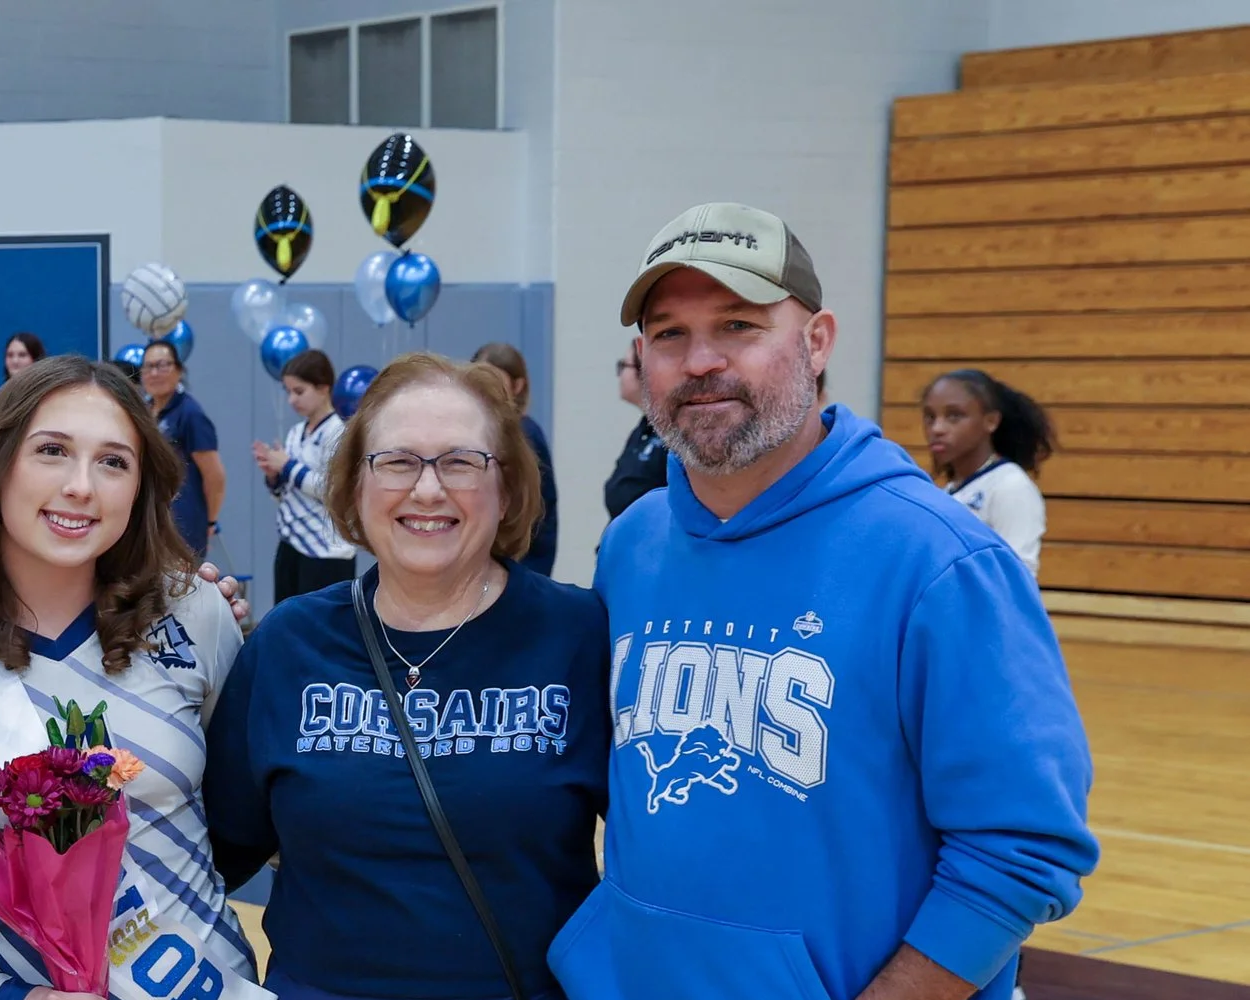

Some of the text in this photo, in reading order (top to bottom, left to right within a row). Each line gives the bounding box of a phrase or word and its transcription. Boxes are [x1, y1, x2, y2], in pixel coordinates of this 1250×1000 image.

[644, 620, 779, 642] DETROIT
[300, 683, 570, 742] CORSAIRS
[610, 632, 835, 789] LIONS
[491, 735, 567, 755] MOTT
[747, 765, 808, 802] NFL COMBINE
